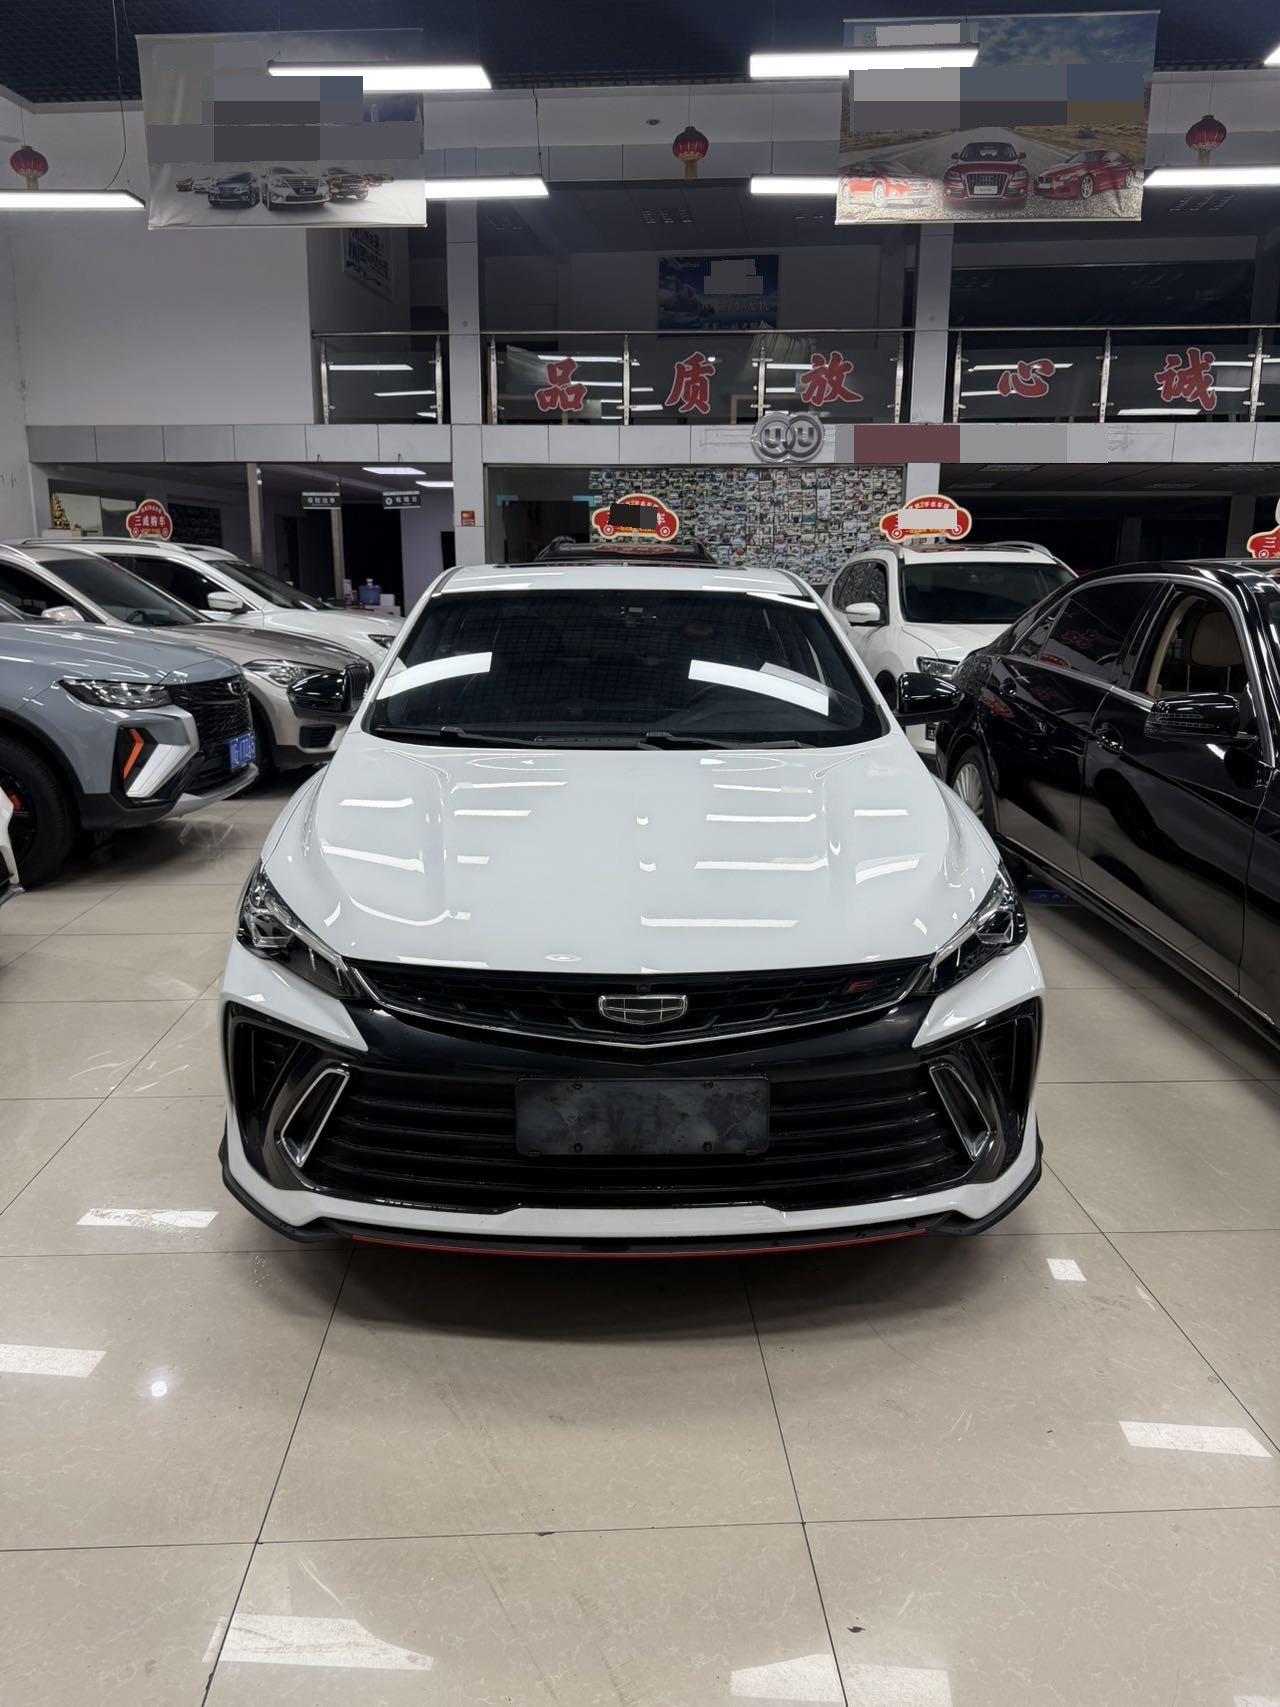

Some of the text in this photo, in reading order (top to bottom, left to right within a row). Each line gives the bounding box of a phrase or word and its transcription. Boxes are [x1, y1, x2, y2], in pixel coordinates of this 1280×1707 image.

[535, 347, 1217, 414] 品 质 放 心 诚
